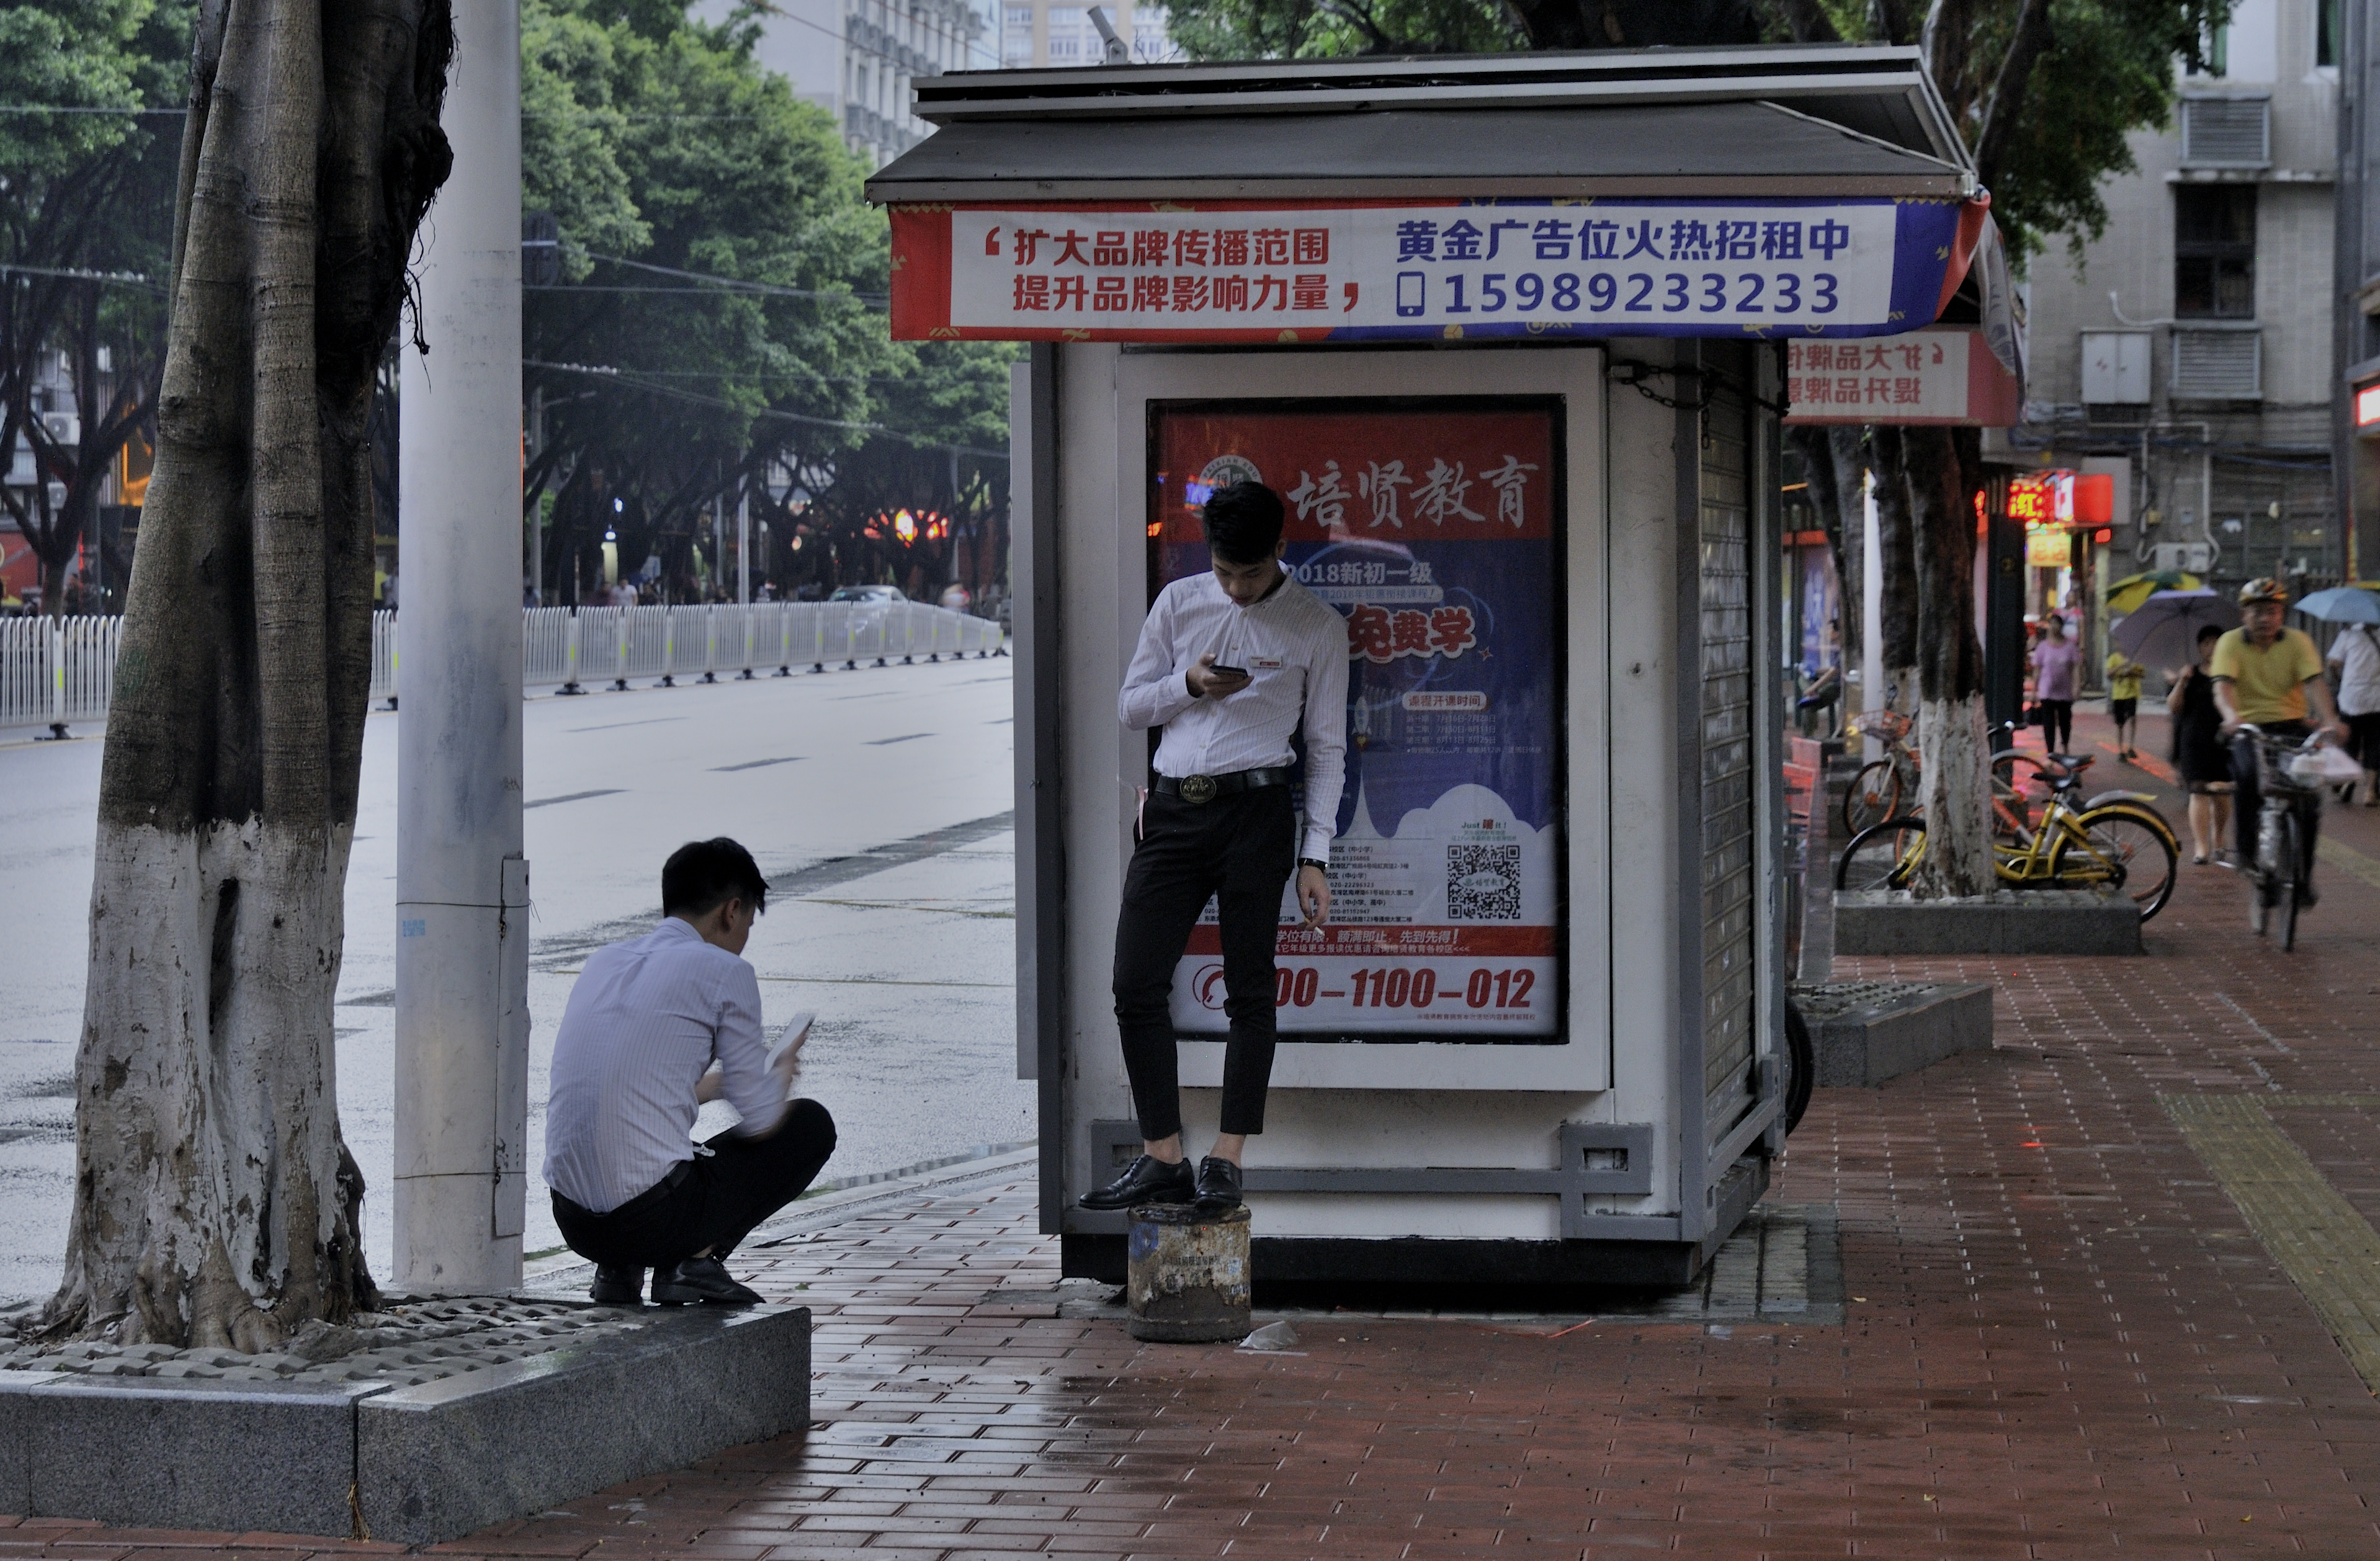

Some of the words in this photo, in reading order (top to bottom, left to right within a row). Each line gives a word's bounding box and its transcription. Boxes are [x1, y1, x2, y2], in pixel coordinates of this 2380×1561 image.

[1395, 219, 1850, 263] 黄金广告位火热招租中
[1445, 272, 1839, 314] 15989233233
[1286, 454, 1539, 529] 培贤教育
[1288, 561, 1432, 584] 2018新初一级
[1346, 604, 1473, 658] 免费学
[1408, 695, 1481, 707] 课程开课时间
